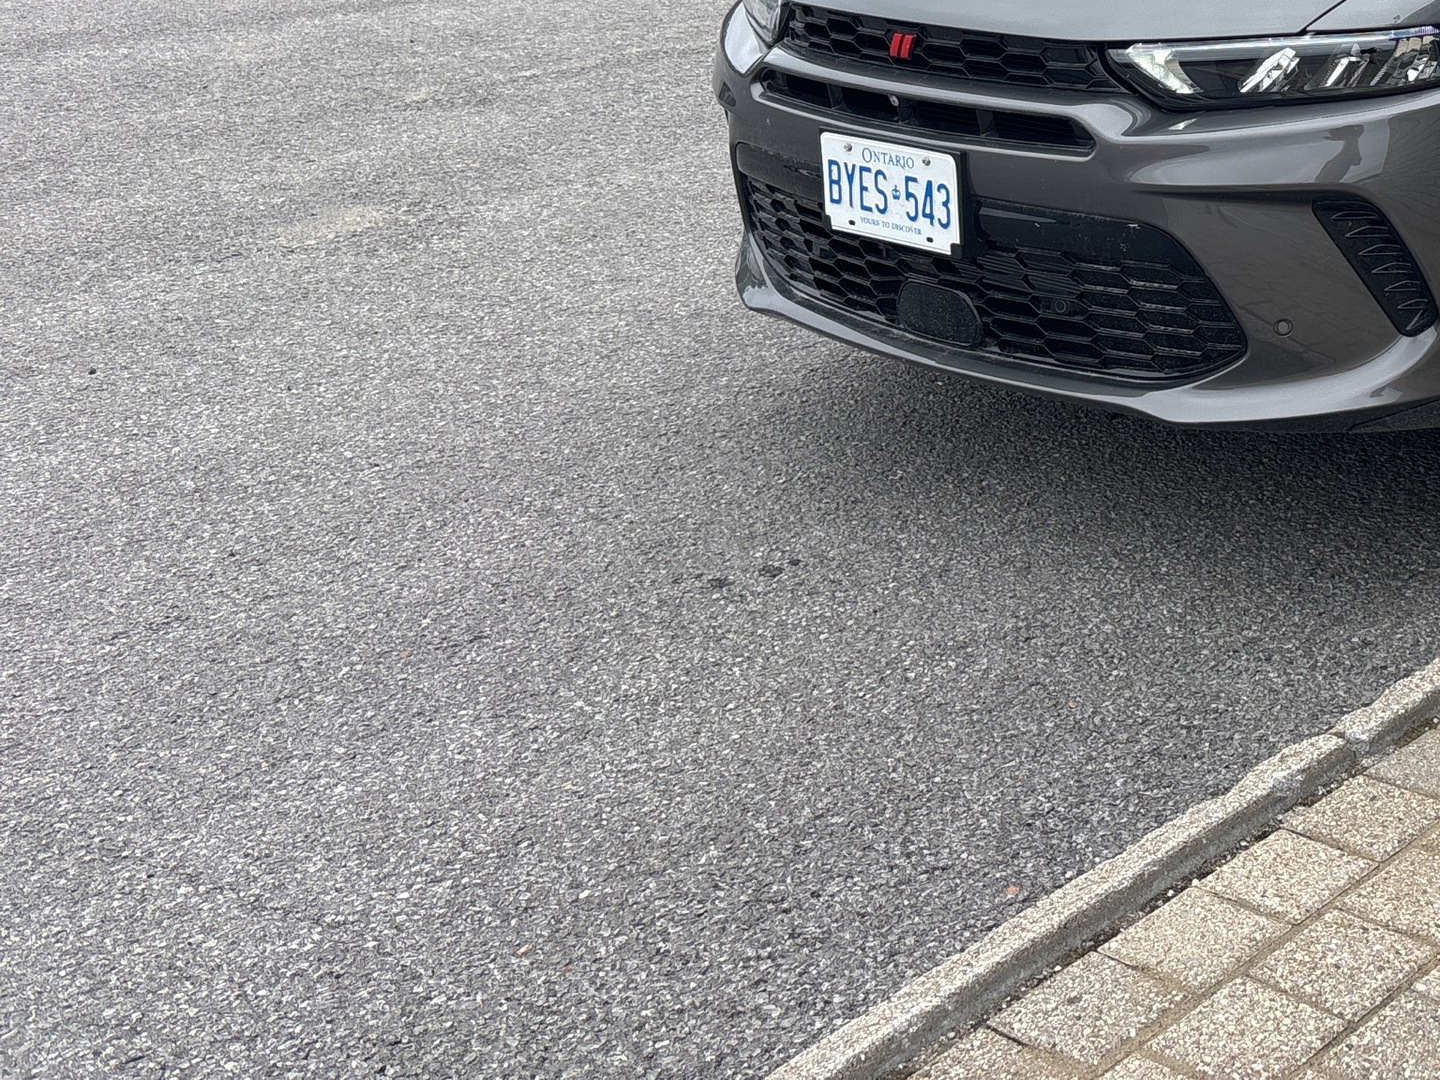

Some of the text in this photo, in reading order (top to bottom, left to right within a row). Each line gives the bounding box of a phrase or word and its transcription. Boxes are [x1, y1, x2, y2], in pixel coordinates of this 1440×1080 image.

[862, 147, 914, 170] ONTARIO
[860, 216, 880, 226] YOURS
[891, 223, 922, 235] DISCOVER
